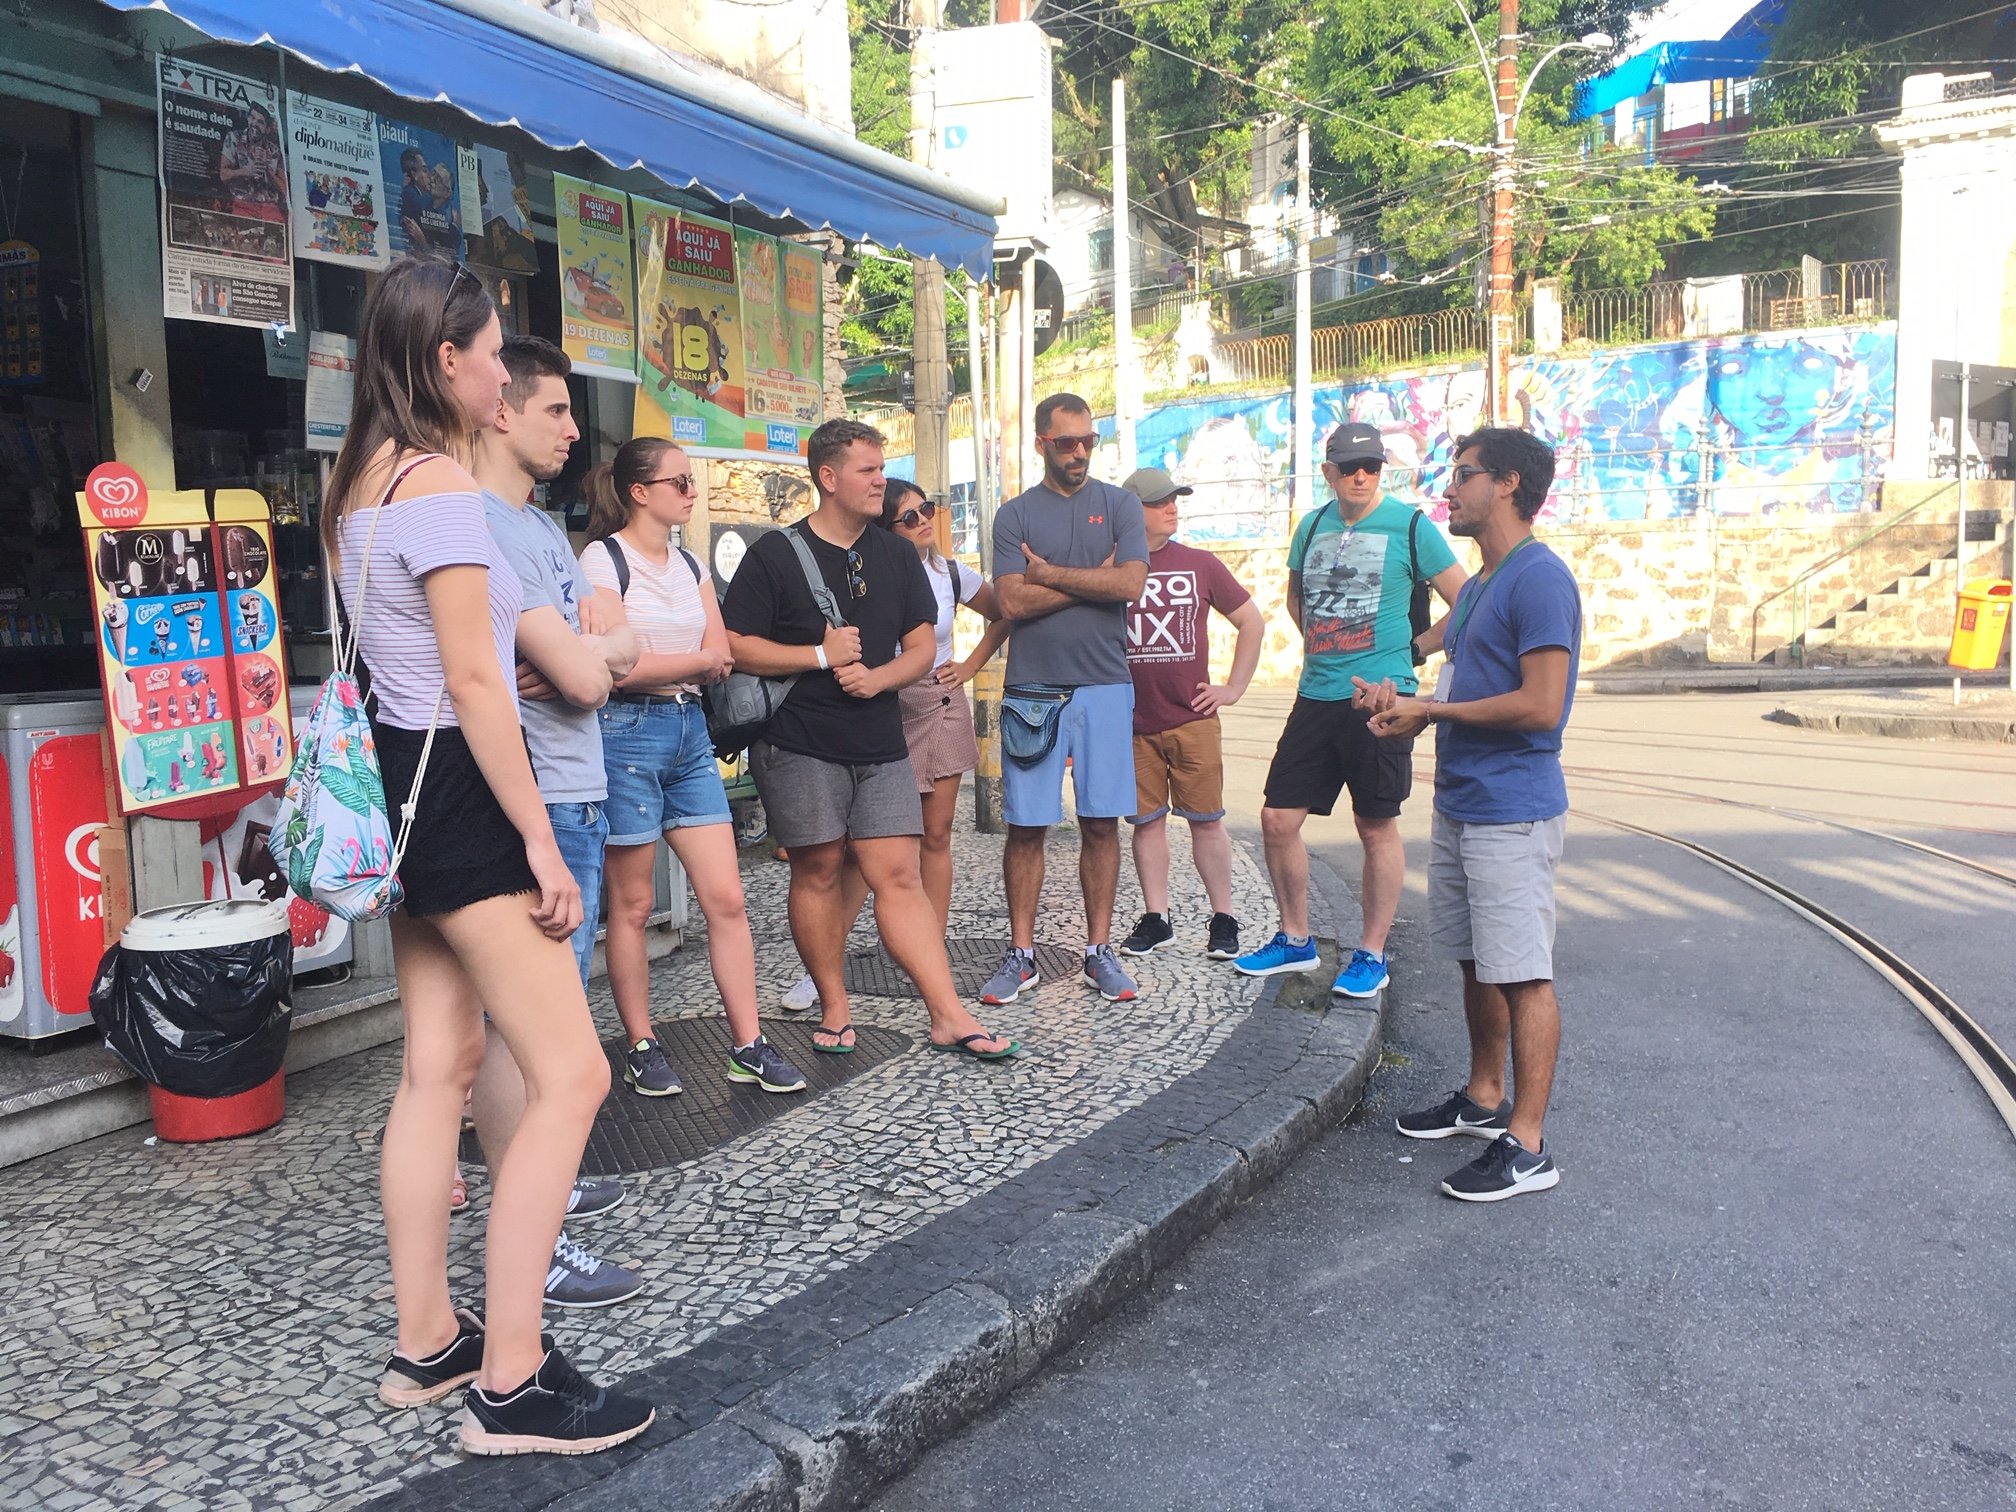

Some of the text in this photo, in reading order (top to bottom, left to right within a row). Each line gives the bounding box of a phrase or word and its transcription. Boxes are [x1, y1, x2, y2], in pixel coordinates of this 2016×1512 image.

[161, 64, 250, 106] EXTRA
[164, 100, 233, 128] O nome dele
[314, 108, 322, 119] 22
[338, 115, 347, 126] 34
[165, 117, 221, 140] é saudade
[380, 121, 408, 144] piauí
[295, 127, 374, 161] diplomatique
[308, 156, 322, 166] BRASIL
[460, 154, 475, 170] PB
[585, 200, 604, 211] AQUI
[606, 205, 615, 214] JÁ
[592, 210, 610, 221] SAIU
[581, 218, 621, 233] GANHADOR
[676, 230, 704, 246] AQUI
[707, 235, 720, 250] JÁ
[685, 246, 712, 262] SAIU
[668, 258, 730, 280] GANHADOR
[255, 284, 278, 292] chacina
[565, 323, 629, 345] 19 DEZENAS
[672, 322, 710, 370] 18
[674, 370, 708, 381] DEZENAS
[746, 387, 765, 413] 16
[674, 418, 702, 435] Loterj
[768, 425, 796, 447] Loterj
[102, 508, 139, 518] KIBON
[141, 539, 158, 554] M
[1127, 576, 1192, 608] RO
[238, 624, 266, 636] SNICKERS
